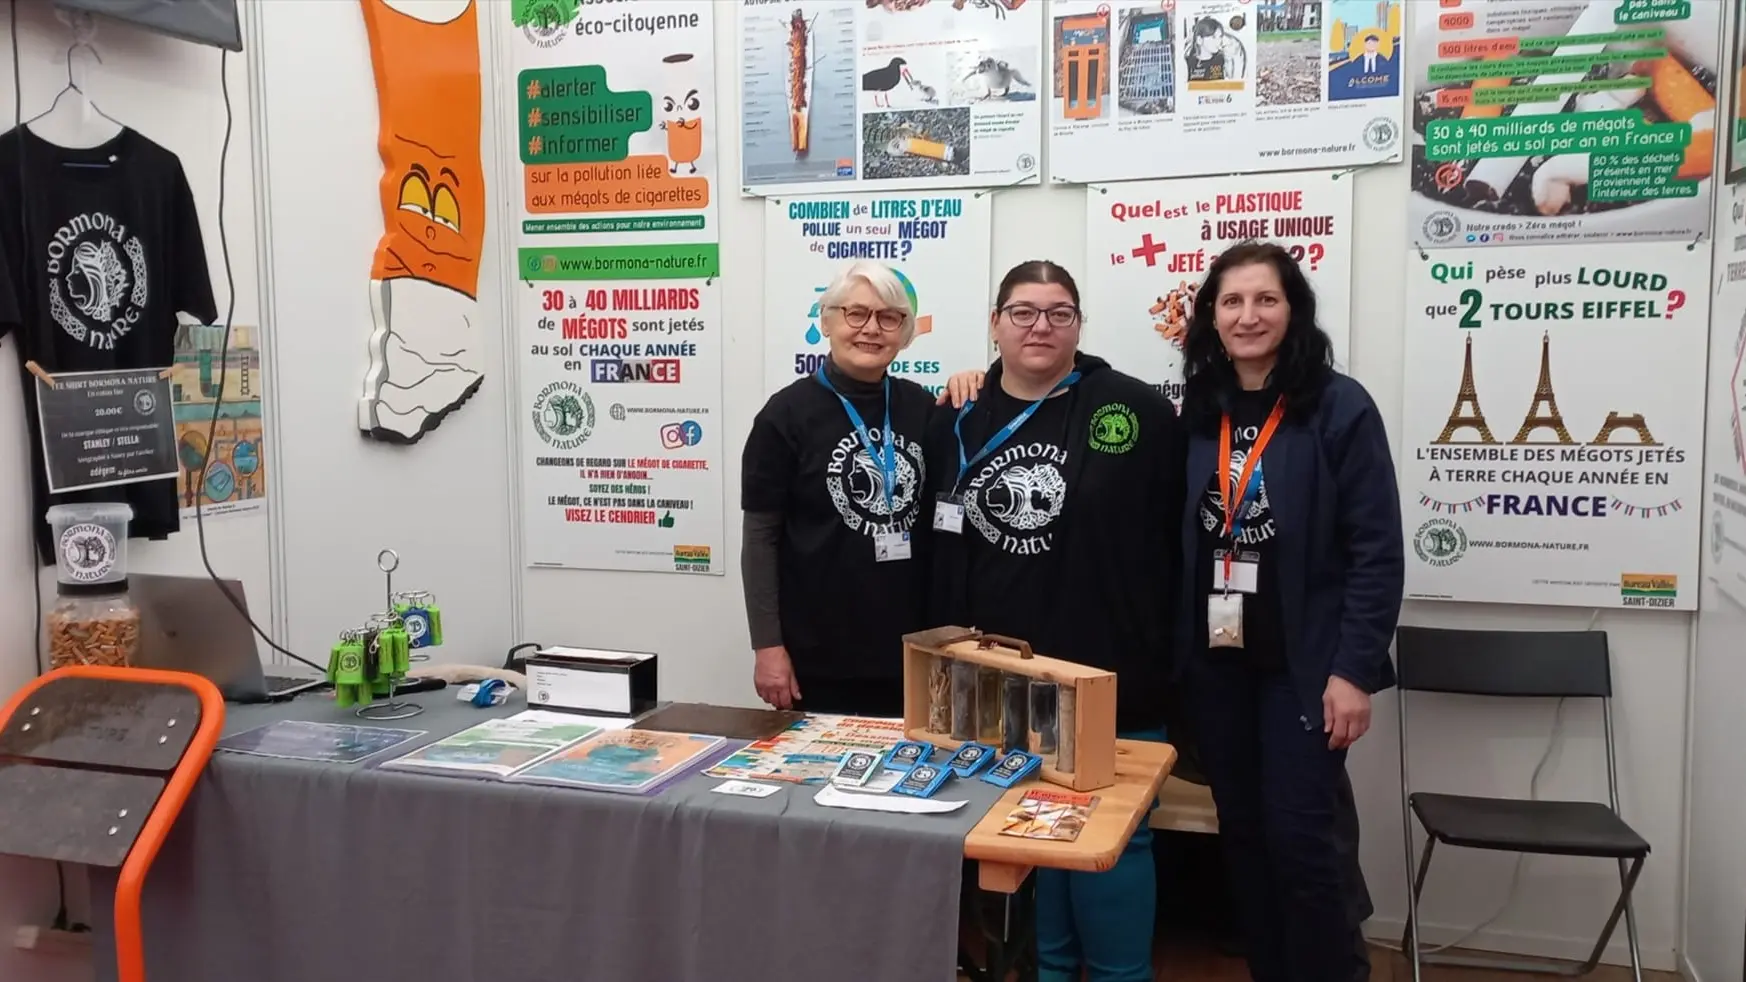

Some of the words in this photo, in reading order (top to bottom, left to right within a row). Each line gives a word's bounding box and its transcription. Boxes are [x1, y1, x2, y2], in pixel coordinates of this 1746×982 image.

[1444, 16, 1469, 25] 4000
[1619, 11, 1628, 20] le
[1632, 10, 1678, 20] caniveau
[575, 13, 699, 36] éco-citoyenne
[1442, 46, 1461, 55] 500
[1464, 43, 1488, 53] litres
[527, 77, 597, 100] #alerter
[1453, 95, 1469, 103] ans
[528, 105, 643, 127] #sensibiliser
[1433, 126, 1450, 140] 30
[1455, 126, 1464, 138] à
[1468, 123, 1487, 137] 40
[1493, 120, 1555, 135] milliards
[1560, 118, 1577, 133] de
[1582, 116, 1635, 133] mégots
[528, 135, 618, 155] #informer
[1433, 142, 1462, 156] sont
[1466, 140, 1499, 156] jetés
[1503, 142, 1520, 151] au
[1524, 137, 1545, 151] sol
[1550, 139, 1575, 152] par
[1579, 137, 1597, 148] an
[1601, 135, 1619, 147] en
[1625, 131, 1674, 145] France
[1593, 156, 1606, 166] 80
[1609, 155, 1619, 165] %
[1621, 154, 1639, 165] des
[1642, 152, 1680, 164] déchets
[531, 170, 551, 184] sur
[557, 168, 568, 183] la
[573, 165, 632, 185] pollution
[636, 163, 661, 180] liée
[1593, 167, 1636, 178] présents
[1654, 165, 1674, 173] mer
[1593, 177, 1651, 188] proviennent
[1654, 175, 1666, 184] de
[531, 194, 556, 208] aux
[561, 192, 609, 209] mégots
[614, 188, 630, 203] de
[635, 186, 702, 207] cigarettes
[1592, 187, 1637, 198] l'intérieur
[1642, 186, 1659, 196] des
[789, 200, 850, 220] COMBIEN
[853, 203, 868, 216] de
[871, 200, 917, 219] LITRES
[921, 198, 962, 217] D'EAU
[1111, 200, 1161, 222] Quel
[1163, 205, 1188, 219] est
[1196, 200, 1210, 213] le
[1215, 191, 1303, 214] PLASTIQUE
[578, 221, 590, 230] des
[616, 220, 632, 231] pour
[652, 218, 702, 228] environnement
[802, 222, 841, 237] POLLUE
[846, 223, 862, 234] un
[865, 223, 891, 235] seul
[898, 217, 948, 239] MÉGOT
[1200, 219, 1212, 241] à
[1216, 218, 1269, 240] USAGE
[1274, 215, 1334, 237] UNIQUE
[1466, 222, 1490, 232] Notre
[1492, 221, 1517, 230] credo
[1525, 221, 1546, 230] Zéro
[1549, 220, 1576, 231] mégot
[809, 241, 825, 253] de
[560, 253, 708, 270] www.bormona-nature.fr
[1110, 252, 1125, 266] le
[1168, 248, 1205, 273] JETÉ
[1308, 243, 1325, 271] ?
[1431, 261, 1474, 284] Qui
[1485, 265, 1526, 283] pèse
[1535, 271, 1573, 288] plus
[1577, 267, 1668, 292] LOURD
[542, 290, 564, 311] 30
[568, 296, 577, 309] à
[585, 289, 607, 311] 40
[612, 288, 699, 311] MILLIARDS
[1425, 304, 1458, 320] que
[1459, 288, 1483, 329] 2
[1490, 302, 1574, 320] TOURS
[1582, 300, 1662, 319] EIFFEL
[537, 317, 555, 331] de
[562, 313, 628, 340] MÉGOTS
[632, 320, 665, 332] sont
[667, 318, 705, 335] jetés
[531, 344, 549, 355] au
[553, 343, 572, 356] sol
[579, 344, 640, 360] CHAQUE
[645, 340, 697, 357] ANNÉE
[564, 359, 581, 371] en
[594, 362, 677, 382] FRANCE
[890, 361, 910, 374] DE
[913, 361, 940, 373] SES
[88, 378, 126, 389] BORMONA
[127, 375, 157, 385] NATURE
[94, 406, 123, 416] 20.00€
[116, 435, 139, 447] STELLA
[536, 457, 575, 467] CHANGEONS
[576, 458, 584, 467] DE
[586, 458, 611, 468] REGARD
[613, 458, 627, 468] SUR
[628, 459, 637, 468] LE
[637, 457, 661, 470] MÉGOT
[662, 460, 670, 470] DE
[1417, 447, 1518, 461] L'ENSEMBLE
[1523, 449, 1555, 462] DES
[1560, 445, 1633, 463] MÉGOTS
[1636, 446, 1685, 466] JETÉS
[1429, 466, 1441, 482] À
[1445, 469, 1496, 482] TERRE
[1501, 470, 1574, 486] CHAQUE
[1579, 470, 1640, 485] ANNÉE
[1645, 472, 1669, 485] EN
[589, 484, 609, 494] SOYEZ
[611, 484, 624, 494] DES
[625, 483, 647, 495] HÉROS
[548, 496, 556, 506] LE
[583, 497, 592, 506] CE
[593, 497, 611, 507] N'EST
[613, 498, 626, 508] PAS
[627, 498, 645, 508] DANS
[646, 499, 655, 509] LA
[657, 499, 689, 509] CANIVEAU
[1486, 494, 1607, 517] FRANCE
[565, 508, 591, 522] VISEZ
[595, 509, 606, 523] LE
[608, 510, 656, 524] CENDRIER
[1469, 539, 1590, 551] WWW.BORMONA-NATURE.FR
[1622, 596, 1675, 608] SAINT-DIZIER
